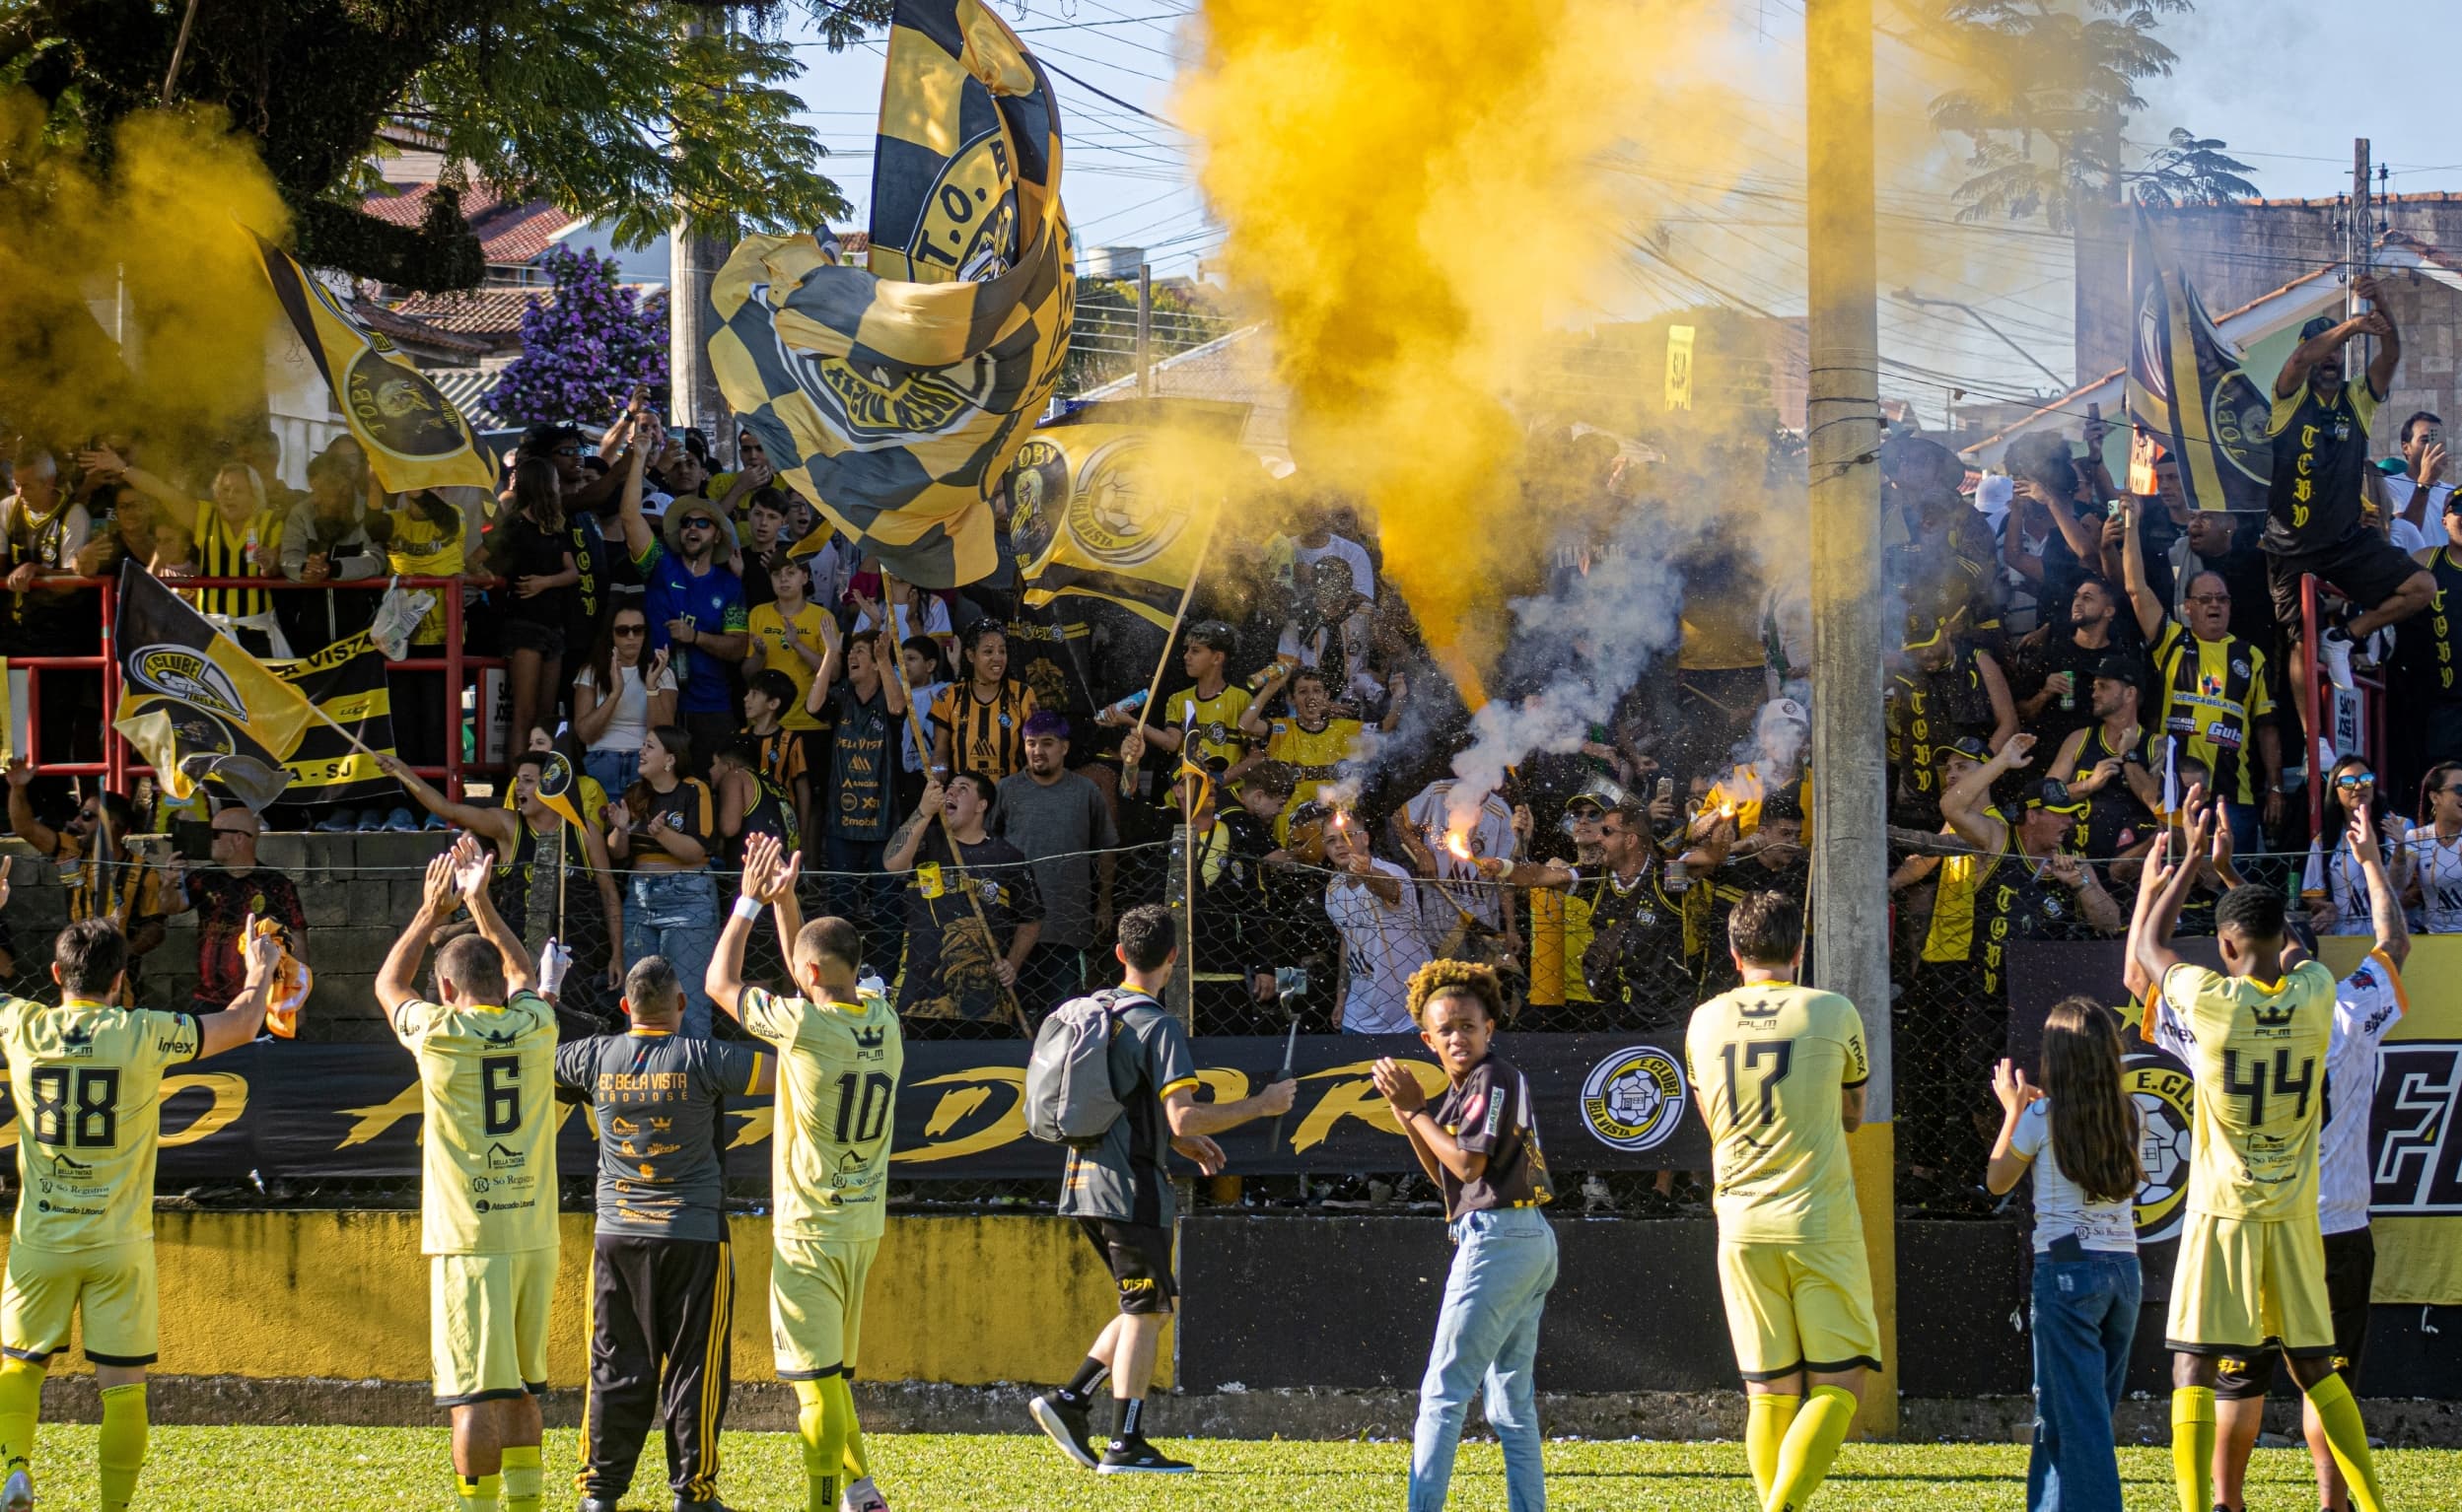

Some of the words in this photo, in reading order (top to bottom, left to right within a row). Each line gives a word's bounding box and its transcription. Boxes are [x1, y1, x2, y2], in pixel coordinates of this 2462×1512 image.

[326, 762, 352, 780] SJ
[1737, 1019, 1778, 1029] PLM
[2254, 1028, 2291, 1037] PLM
[158, 1037, 194, 1055] imex
[857, 1049, 883, 1060] PLM
[599, 1073, 613, 1091] EC
[615, 1073, 649, 1091] BELA
[652, 1071, 687, 1091] VISTA
[1650, 1060, 1679, 1094] CLUBE
[1717, 1040, 1794, 1127] 17
[480, 1054, 522, 1137] 6
[2222, 1048, 2315, 1127] 44
[32, 1066, 121, 1149] 88
[836, 1071, 894, 1144] 10
[1596, 1119, 1631, 1136] VISTA
